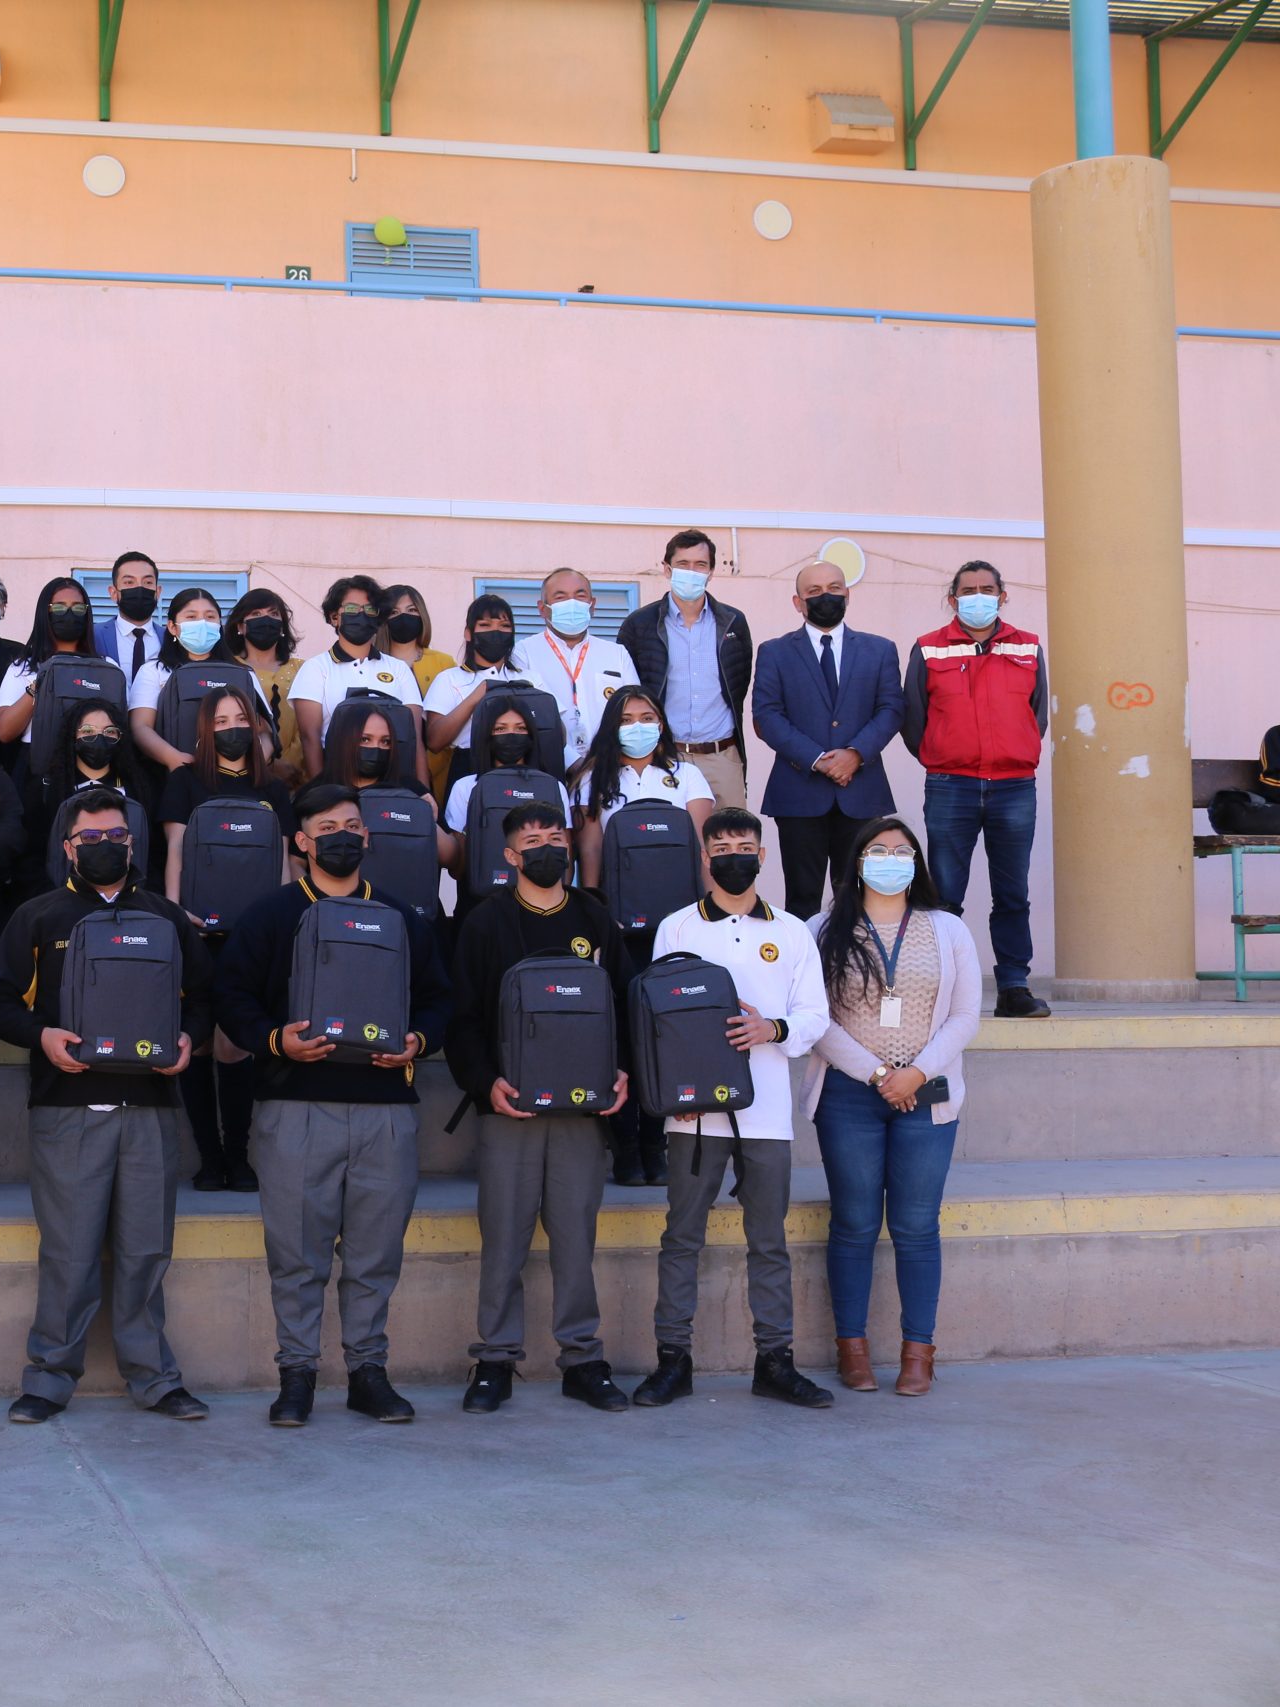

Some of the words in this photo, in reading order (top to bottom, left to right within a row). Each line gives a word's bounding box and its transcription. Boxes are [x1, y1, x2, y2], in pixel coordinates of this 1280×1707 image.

[82, 679, 100, 688] Enaex
[390, 811, 410, 820] Enaex
[230, 823, 252, 831] Enaex
[355, 922, 381, 930] Enaex
[123, 935, 148, 943] Enaex
[556, 985, 581, 993] Enaex
[681, 985, 706, 994] Enaex
[326, 1027, 342, 1035] AIEP
[535, 1098, 551, 1106] AIEP
[678, 1094, 694, 1102] AIEP
